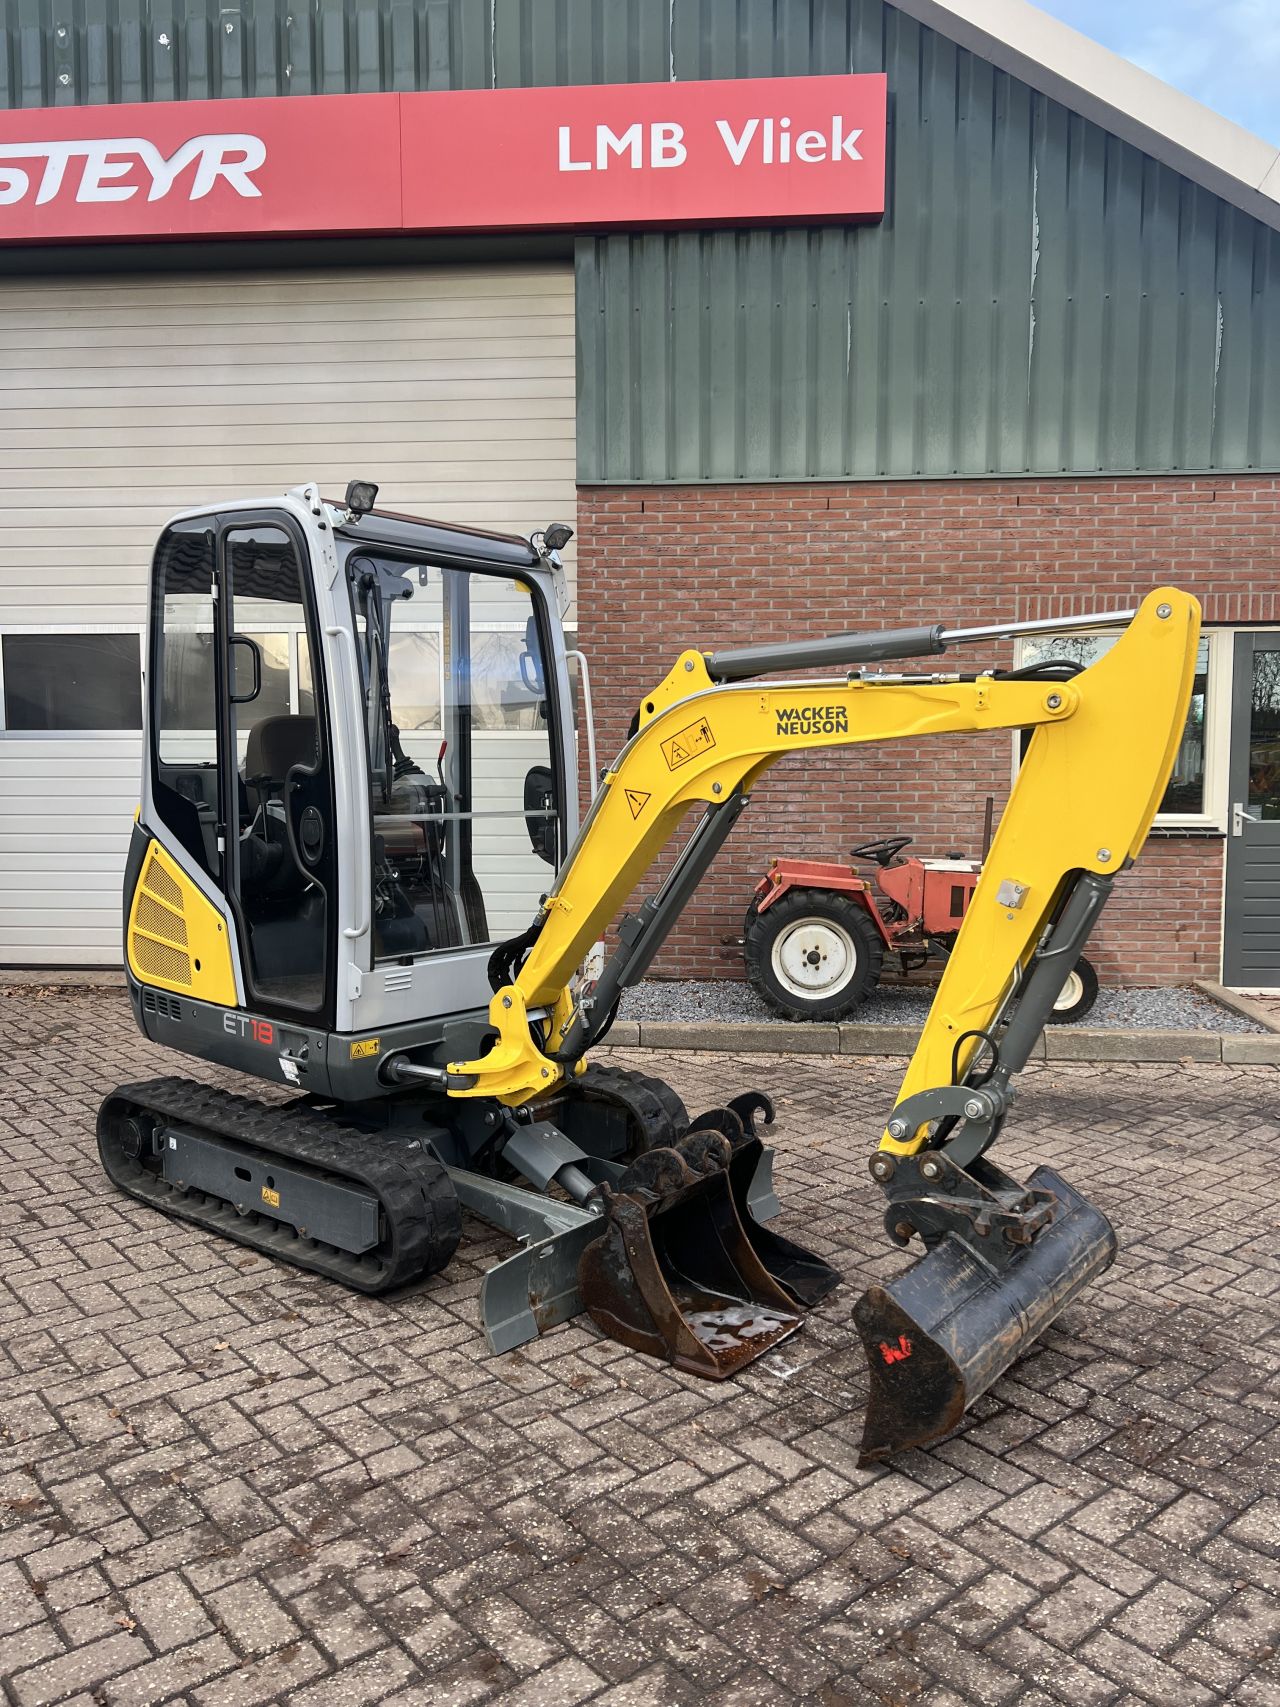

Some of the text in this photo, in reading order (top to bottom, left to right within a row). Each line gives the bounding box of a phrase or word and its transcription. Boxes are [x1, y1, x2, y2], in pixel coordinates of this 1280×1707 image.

[558, 115, 864, 171] LMB Vliek
[775, 706, 848, 721] WACKER
[776, 720, 849, 736] NEUSON
[223, 1012, 273, 1045] ET18
